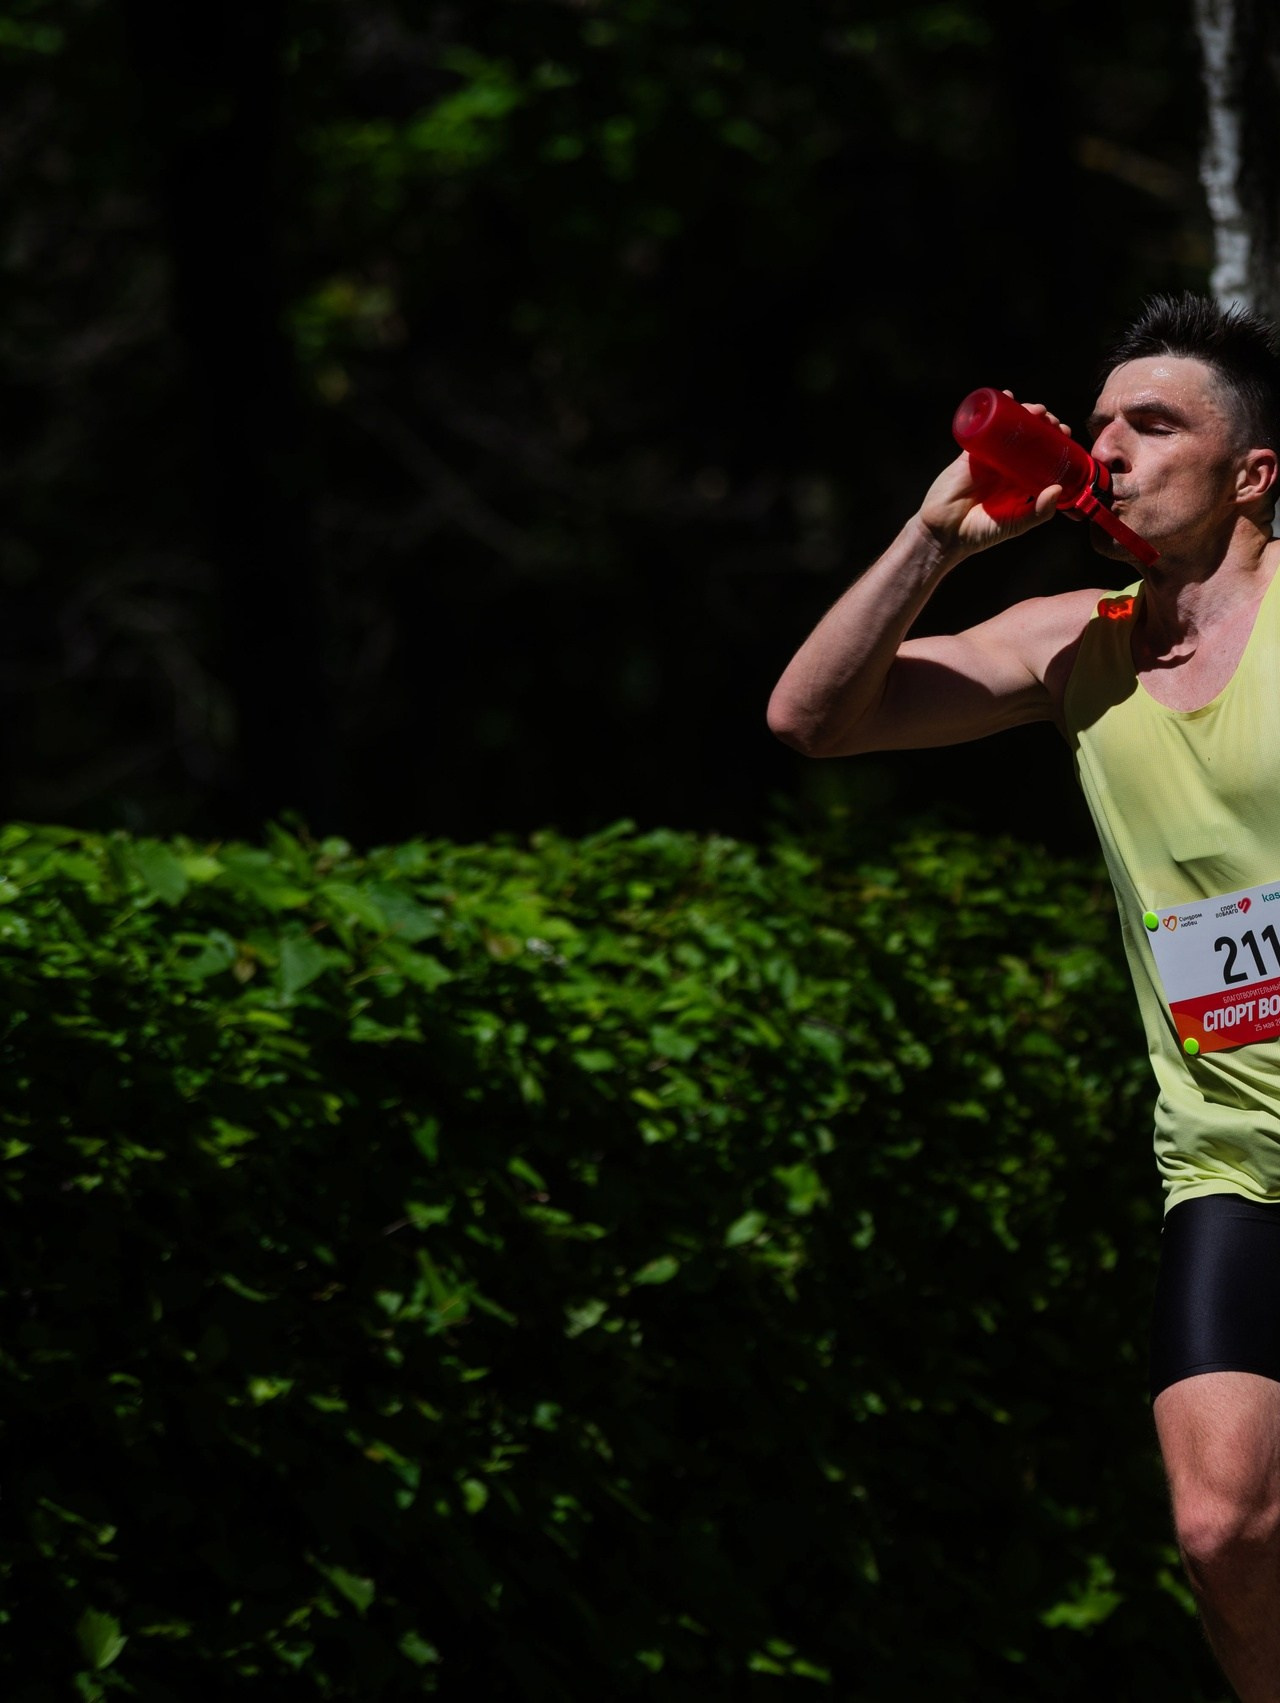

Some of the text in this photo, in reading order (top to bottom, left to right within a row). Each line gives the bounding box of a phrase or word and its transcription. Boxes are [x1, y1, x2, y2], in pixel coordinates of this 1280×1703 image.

[1203, 1001, 1256, 1032] СПОРТ
[1258, 994, 1280, 1019] ВО
[1254, 1023, 1262, 1031] 25
[1263, 1021, 1275, 1029] мая
